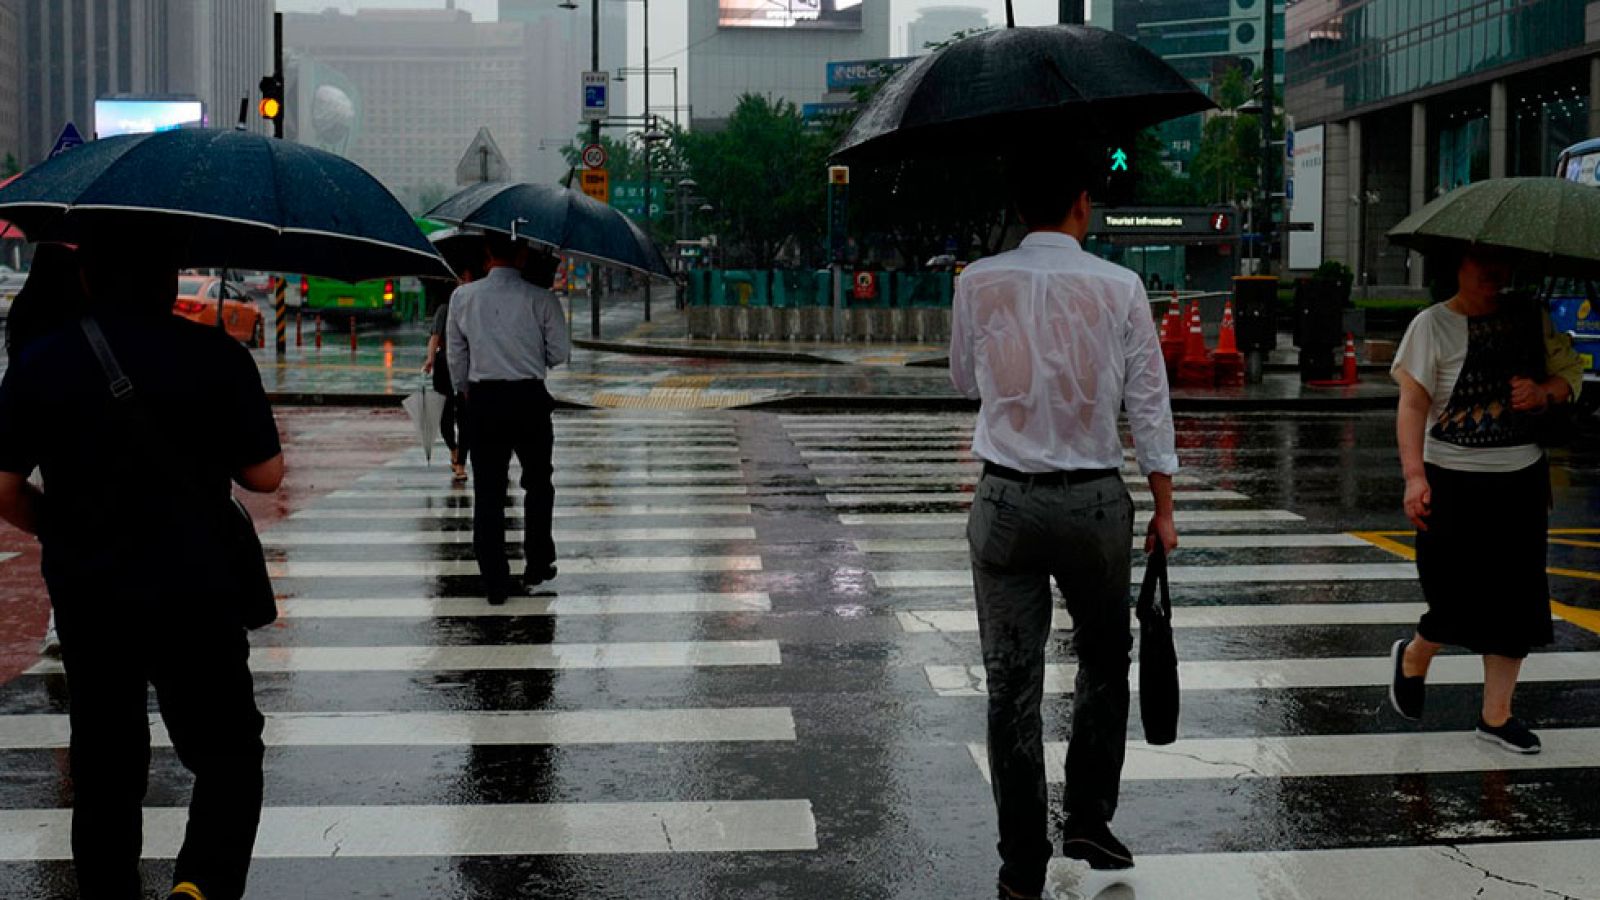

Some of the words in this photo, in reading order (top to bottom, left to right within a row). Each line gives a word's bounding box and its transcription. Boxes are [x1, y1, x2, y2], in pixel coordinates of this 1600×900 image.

[587, 151, 600, 162] 60
[1105, 216, 1134, 226] Tourist
[1135, 216, 1183, 226] Information
